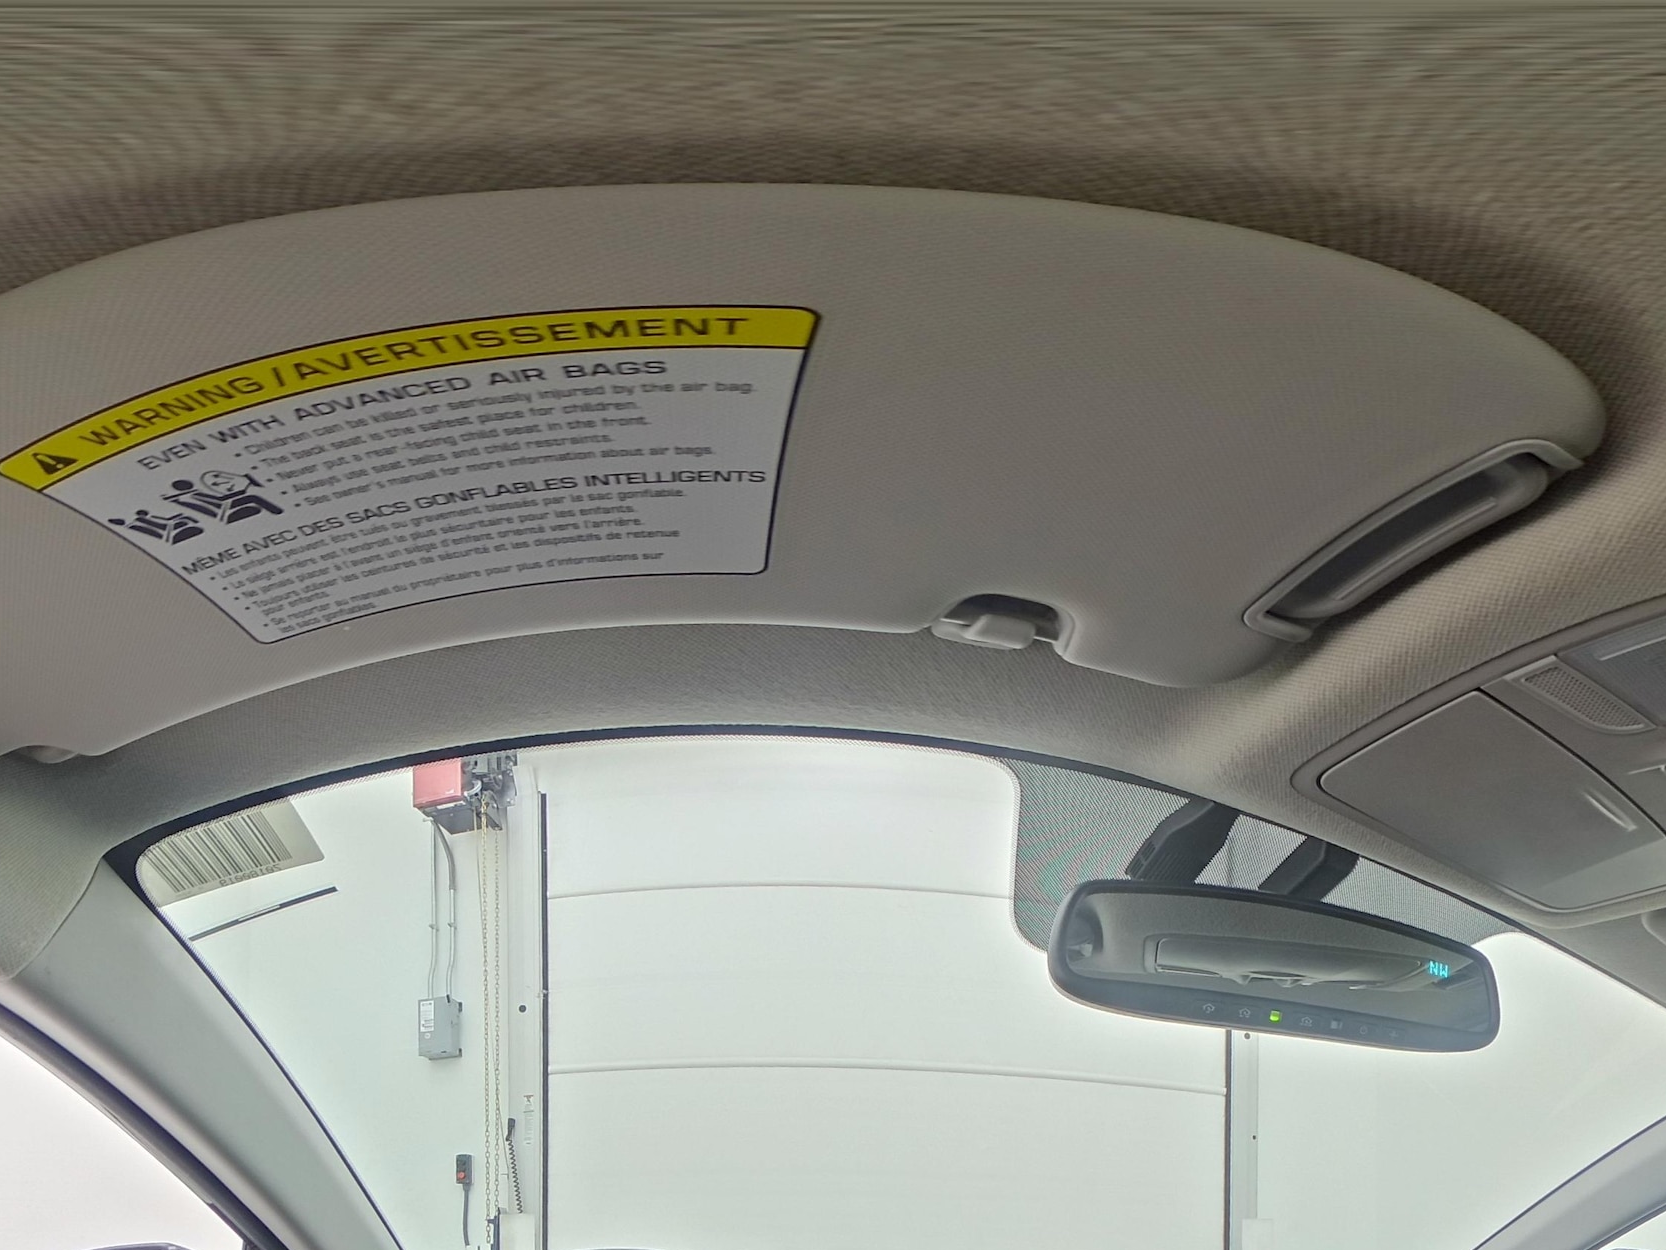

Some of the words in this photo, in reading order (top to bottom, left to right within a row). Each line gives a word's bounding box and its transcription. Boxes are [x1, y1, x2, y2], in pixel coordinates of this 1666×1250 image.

[78, 377, 264, 446] WARNING
[293, 318, 748, 379] AVERTISSEMENT
[136, 440, 205, 470] EVEN
[207, 415, 284, 442] WITH
[293, 377, 471, 420] ADVANCED
[488, 368, 547, 385] AIR
[562, 360, 666, 378] BAGS
[244, 432, 310, 454] Children
[313, 423, 343, 436] can
[344, 418, 369, 428] be
[420, 404, 439, 414] or
[610, 384, 633, 395] by
[640, 383, 674, 392] the
[680, 383, 707, 391] air
[259, 455, 290, 466] The
[528, 407, 554, 416] for
[546, 422, 562, 431] in
[181, 549, 241, 577] MÊME
[242, 529, 296, 553] AVEC
[297, 516, 343, 536] DES
[344, 501, 411, 523] SACS
[414, 477, 578, 507] GONFLABLES
[583, 470, 765, 485] INTELLIGENTS
[1427, 961, 1450, 979] NW
